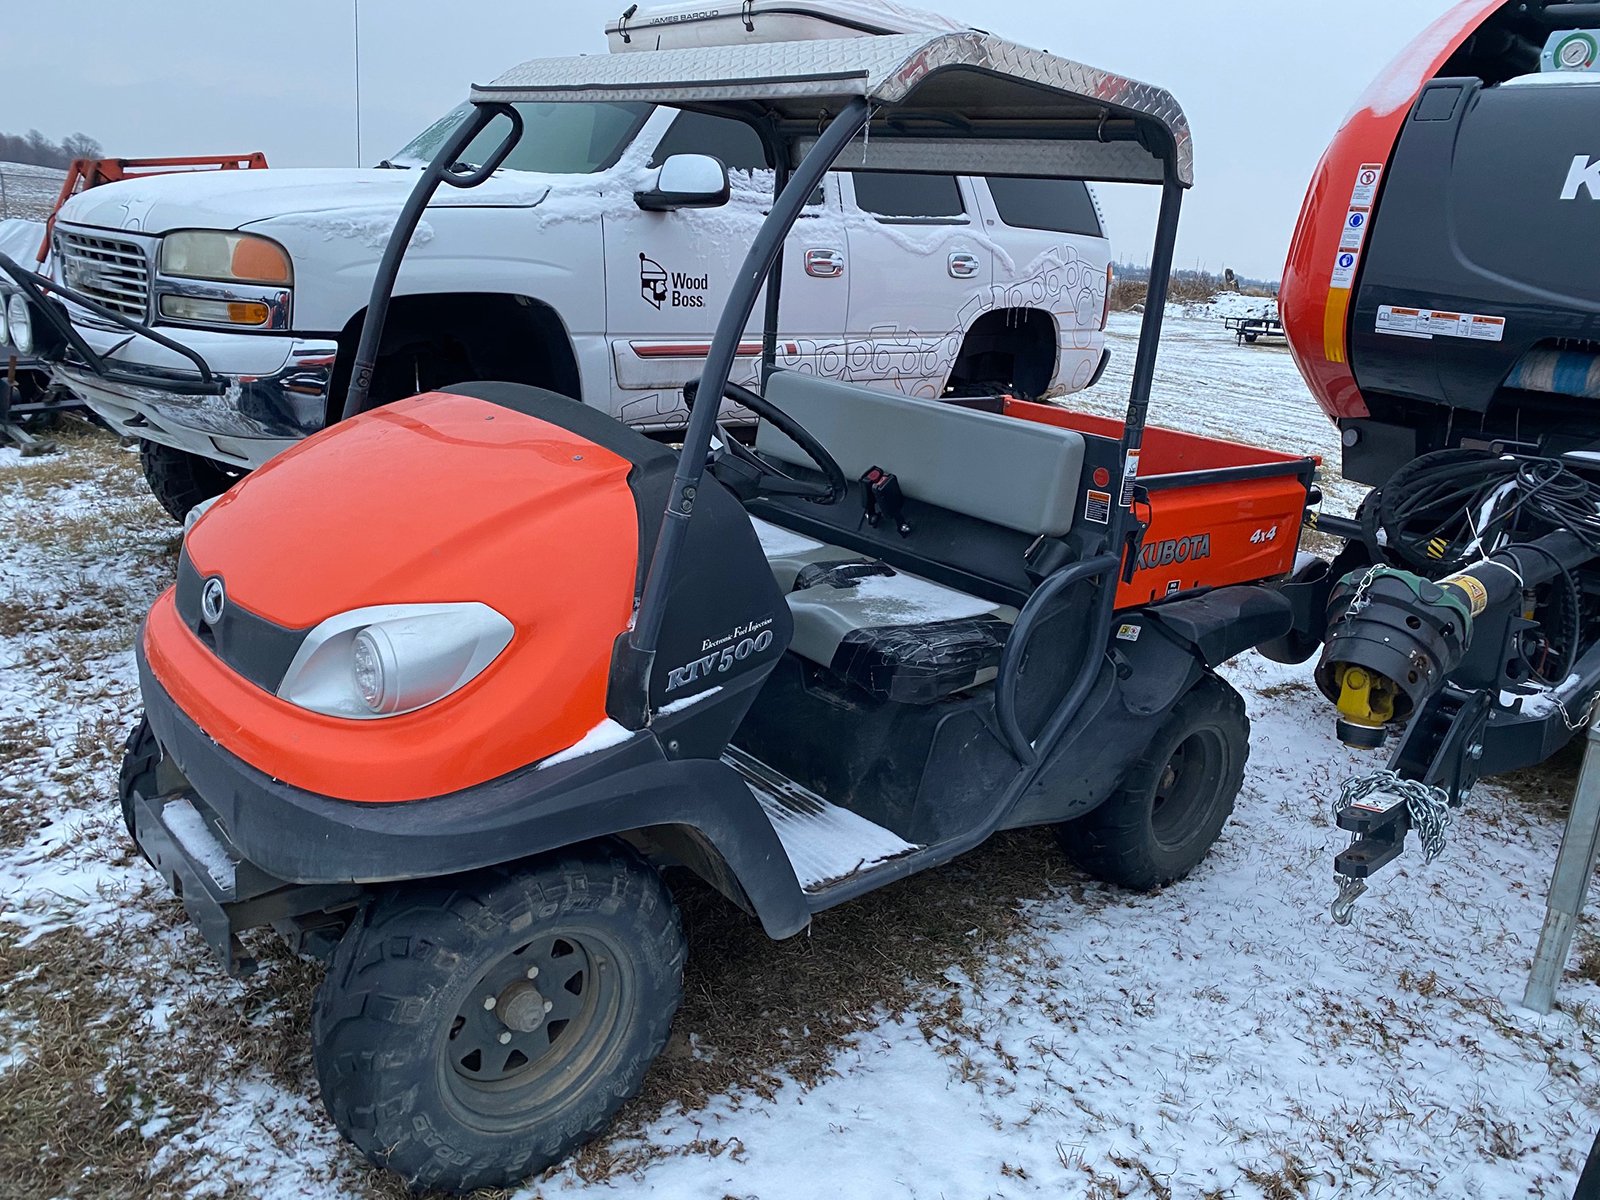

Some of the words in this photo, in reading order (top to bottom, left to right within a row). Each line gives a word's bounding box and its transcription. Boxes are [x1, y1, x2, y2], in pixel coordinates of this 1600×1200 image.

[650, 15, 678, 24] JAMES
[681, 10, 718, 20] BAROUD
[671, 272, 708, 290] Wood
[672, 290, 704, 308] Boss
[1250, 525, 1278, 544] 4x4
[1135, 532, 1211, 572] KUBOTA
[701, 634, 733, 651] Electronic
[733, 626, 748, 638] Fuel
[748, 618, 773, 632] Injection
